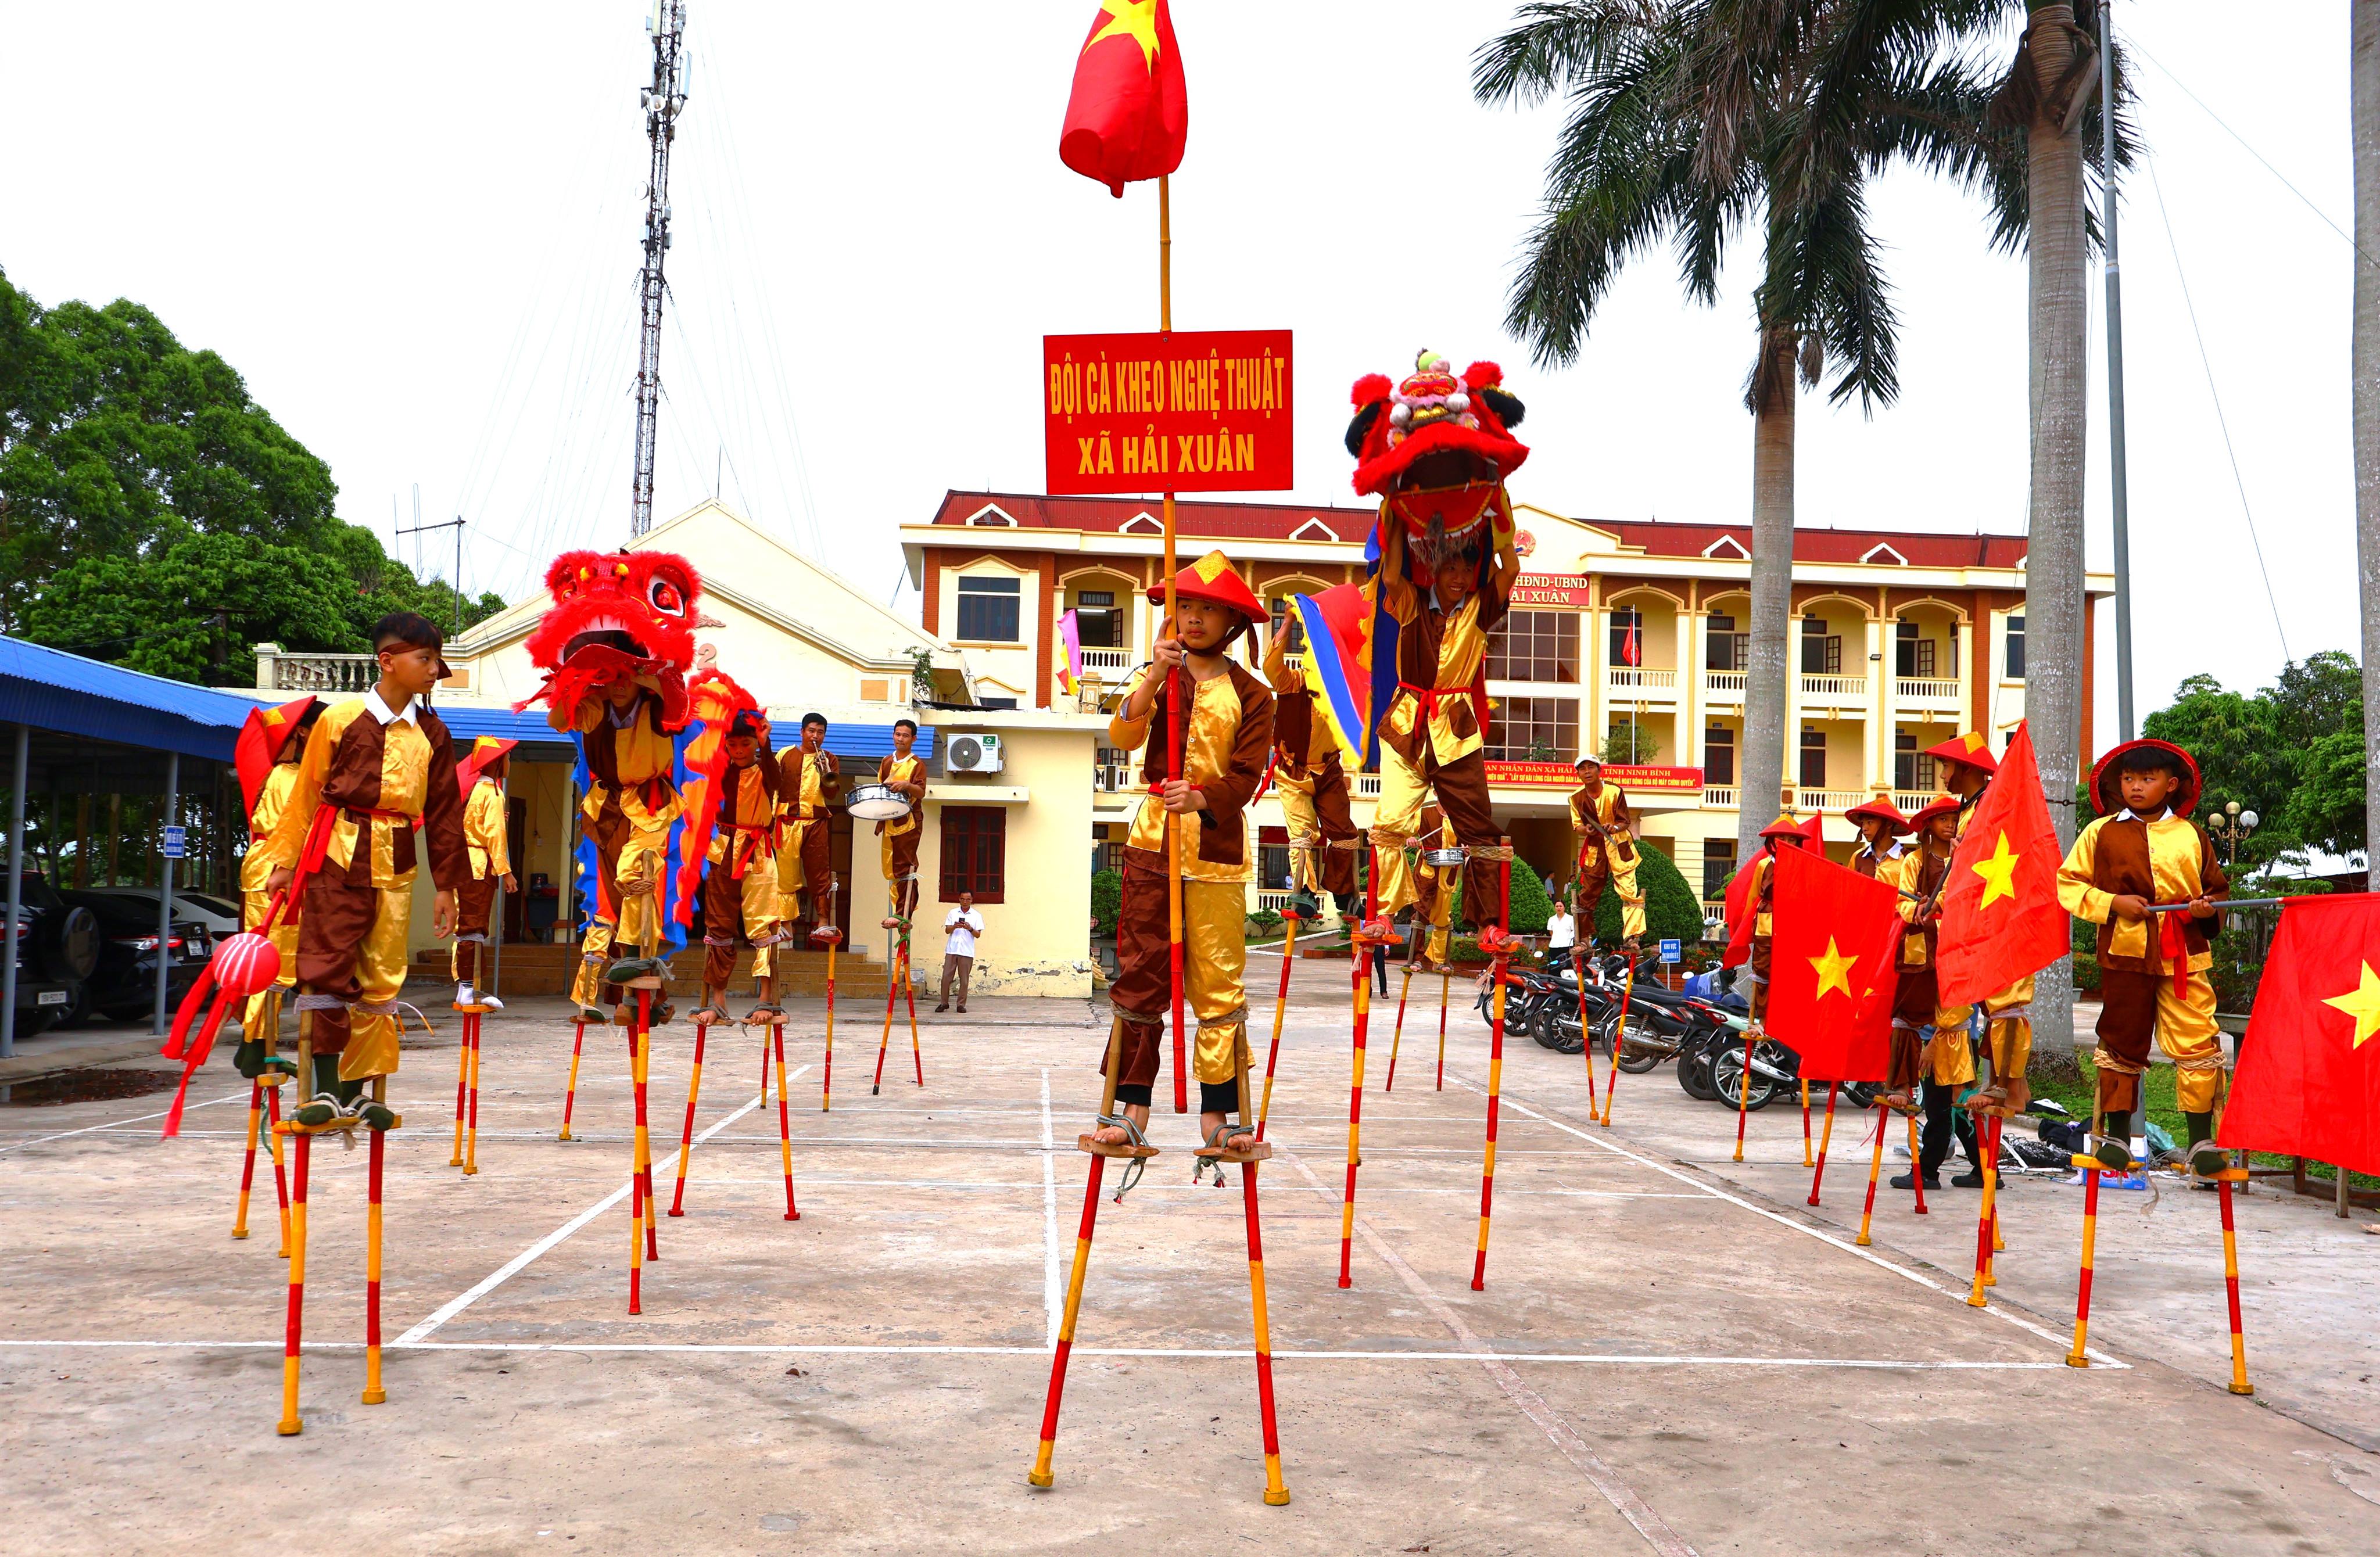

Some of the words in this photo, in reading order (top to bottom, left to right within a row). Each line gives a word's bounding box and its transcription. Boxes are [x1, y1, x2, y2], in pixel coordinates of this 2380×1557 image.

[1050, 352, 1081, 424] ĐỘI
[1087, 351, 1111, 414] CÀ
[1116, 360, 1164, 413] KHEO
[1170, 348, 1220, 420] NGHỆ
[1225, 347, 1284, 419] THUẬT
[1078, 430, 1114, 475] XÃ
[1123, 424, 1168, 473] HẢI
[1177, 427, 1254, 472] XUÂN
[1510, 587, 1526, 601] ẢI
[1530, 589, 1570, 603] XUÂN
[1558, 765, 1572, 773] HẢI
[1604, 767, 1624, 775] TỈNH
